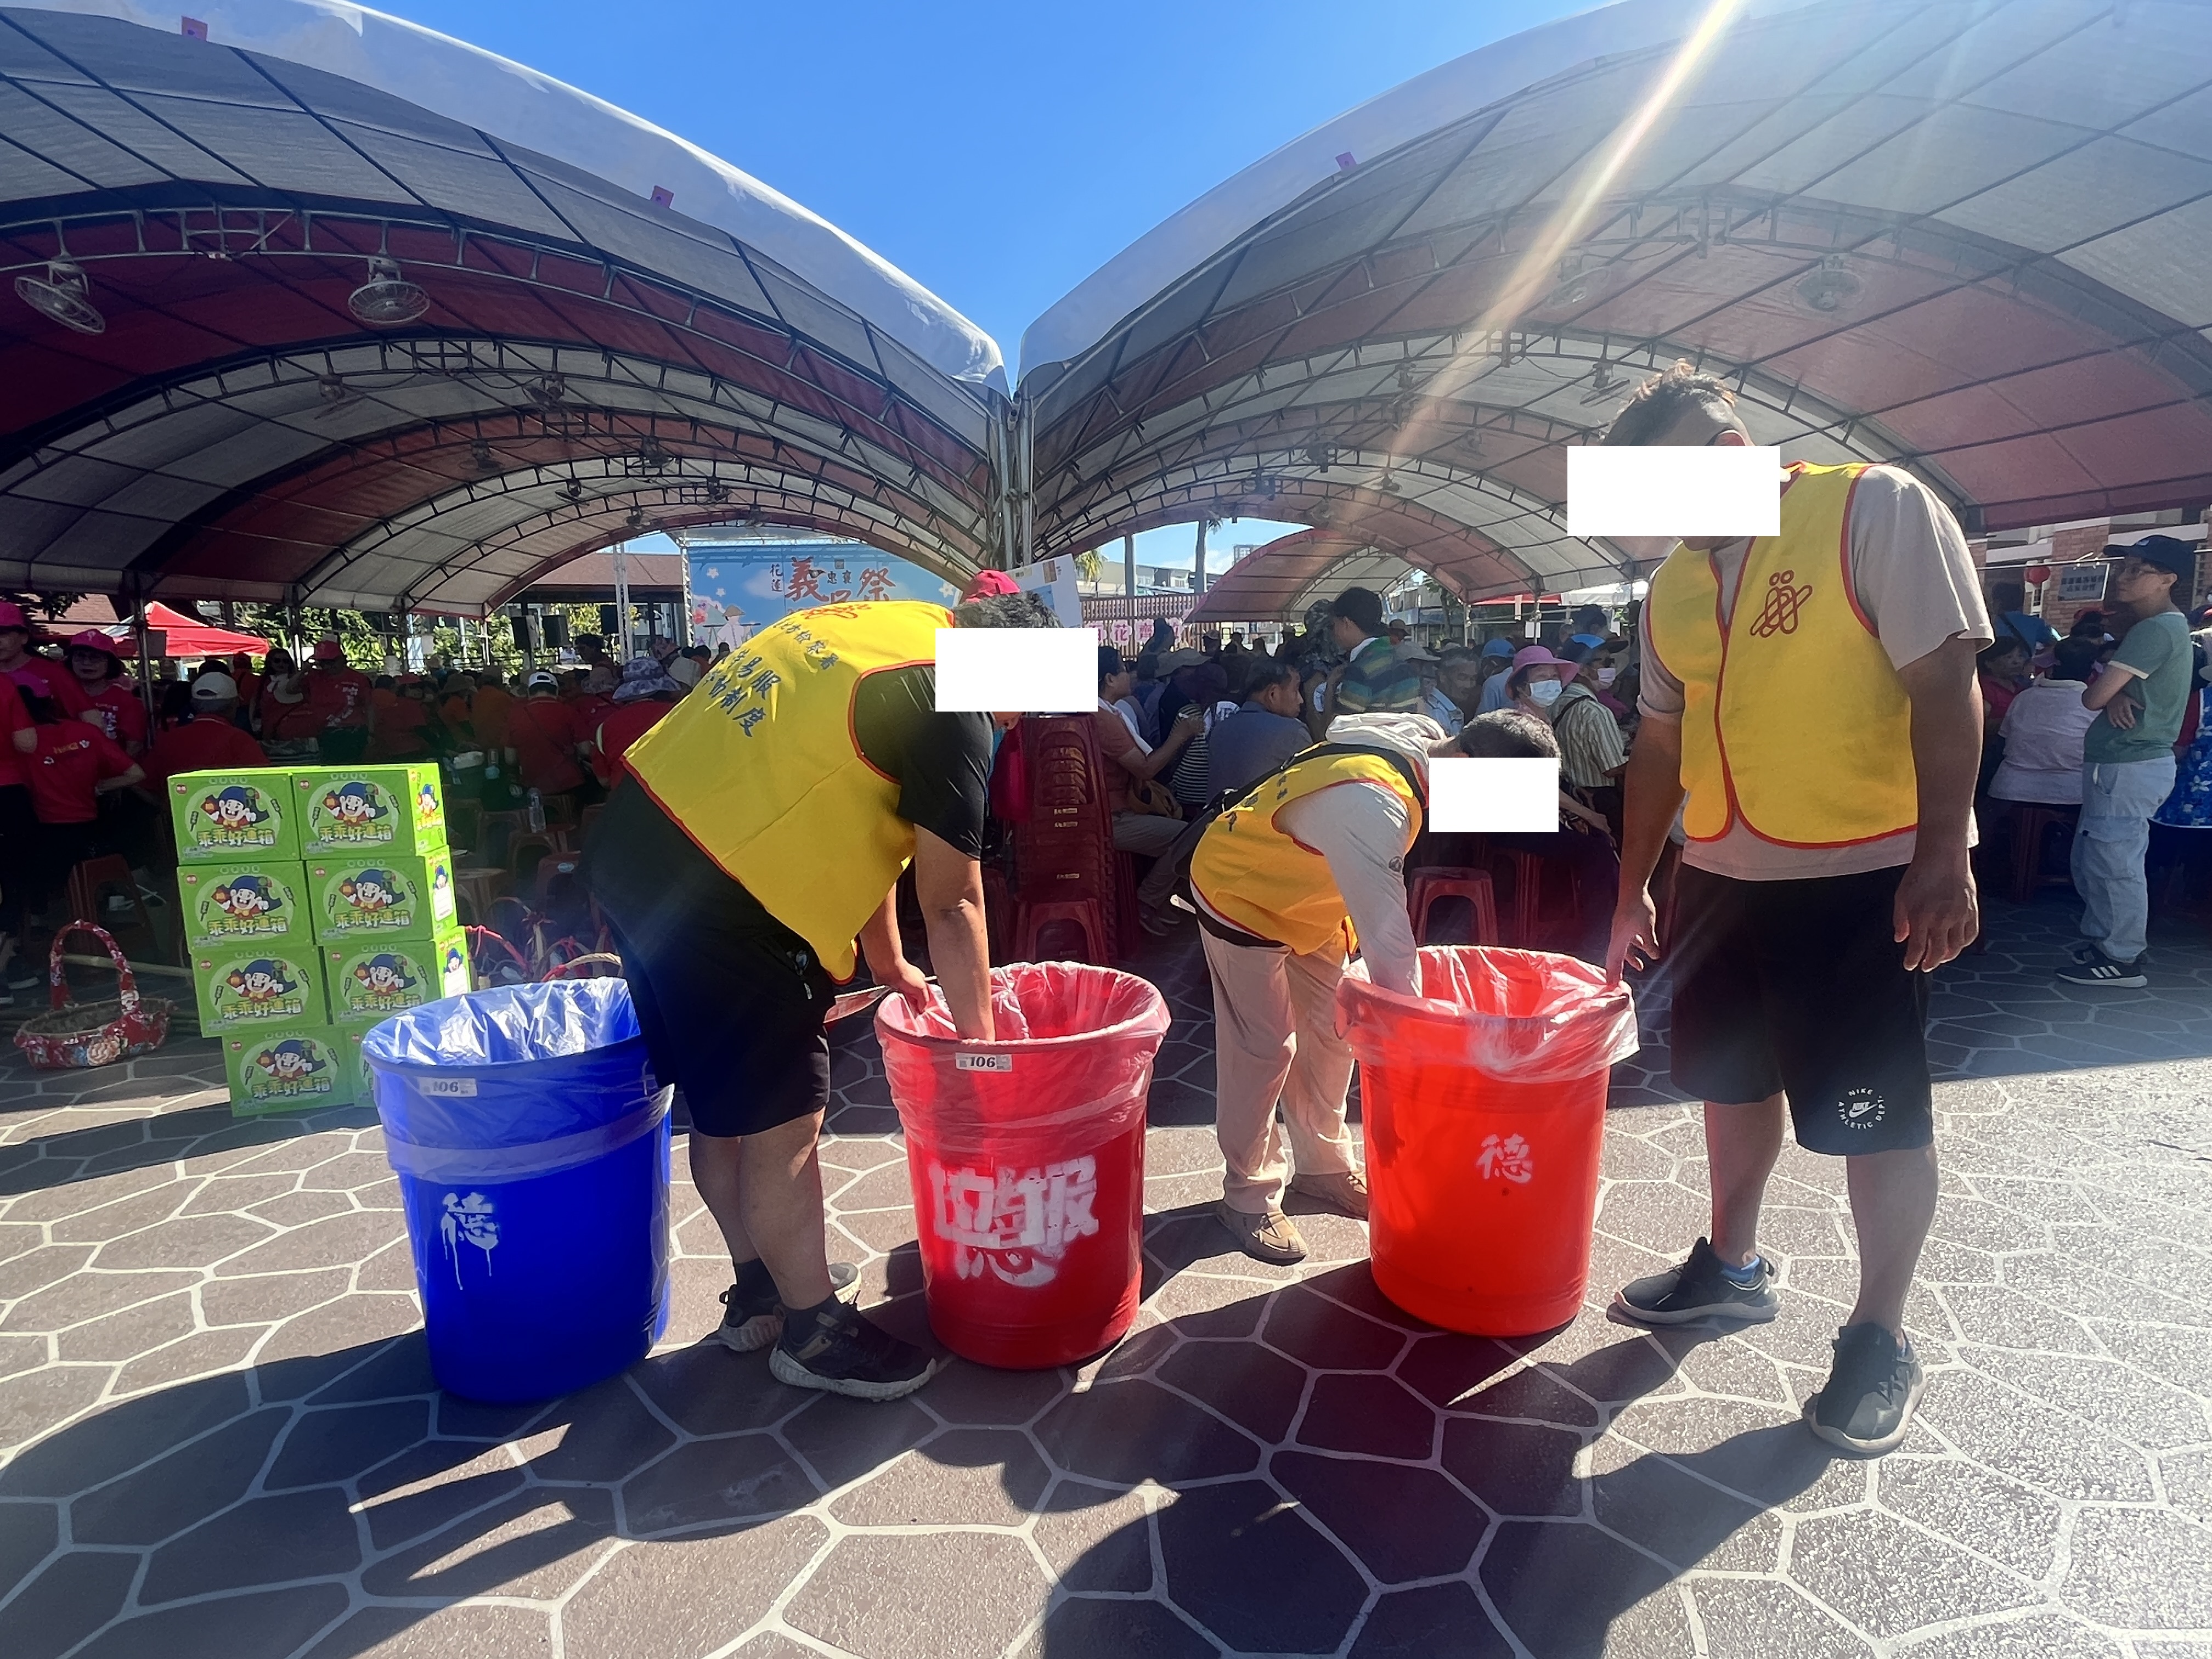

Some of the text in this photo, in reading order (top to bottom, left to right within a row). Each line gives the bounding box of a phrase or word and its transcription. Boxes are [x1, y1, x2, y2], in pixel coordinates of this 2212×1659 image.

[970, 1057, 996, 1068] 106
[433, 1081, 459, 1093] 106
[1848, 1088, 1874, 1097] NIKE
[1838, 1101, 1874, 1130] ATHLETIC
[1476, 1133, 1533, 1185] 德
